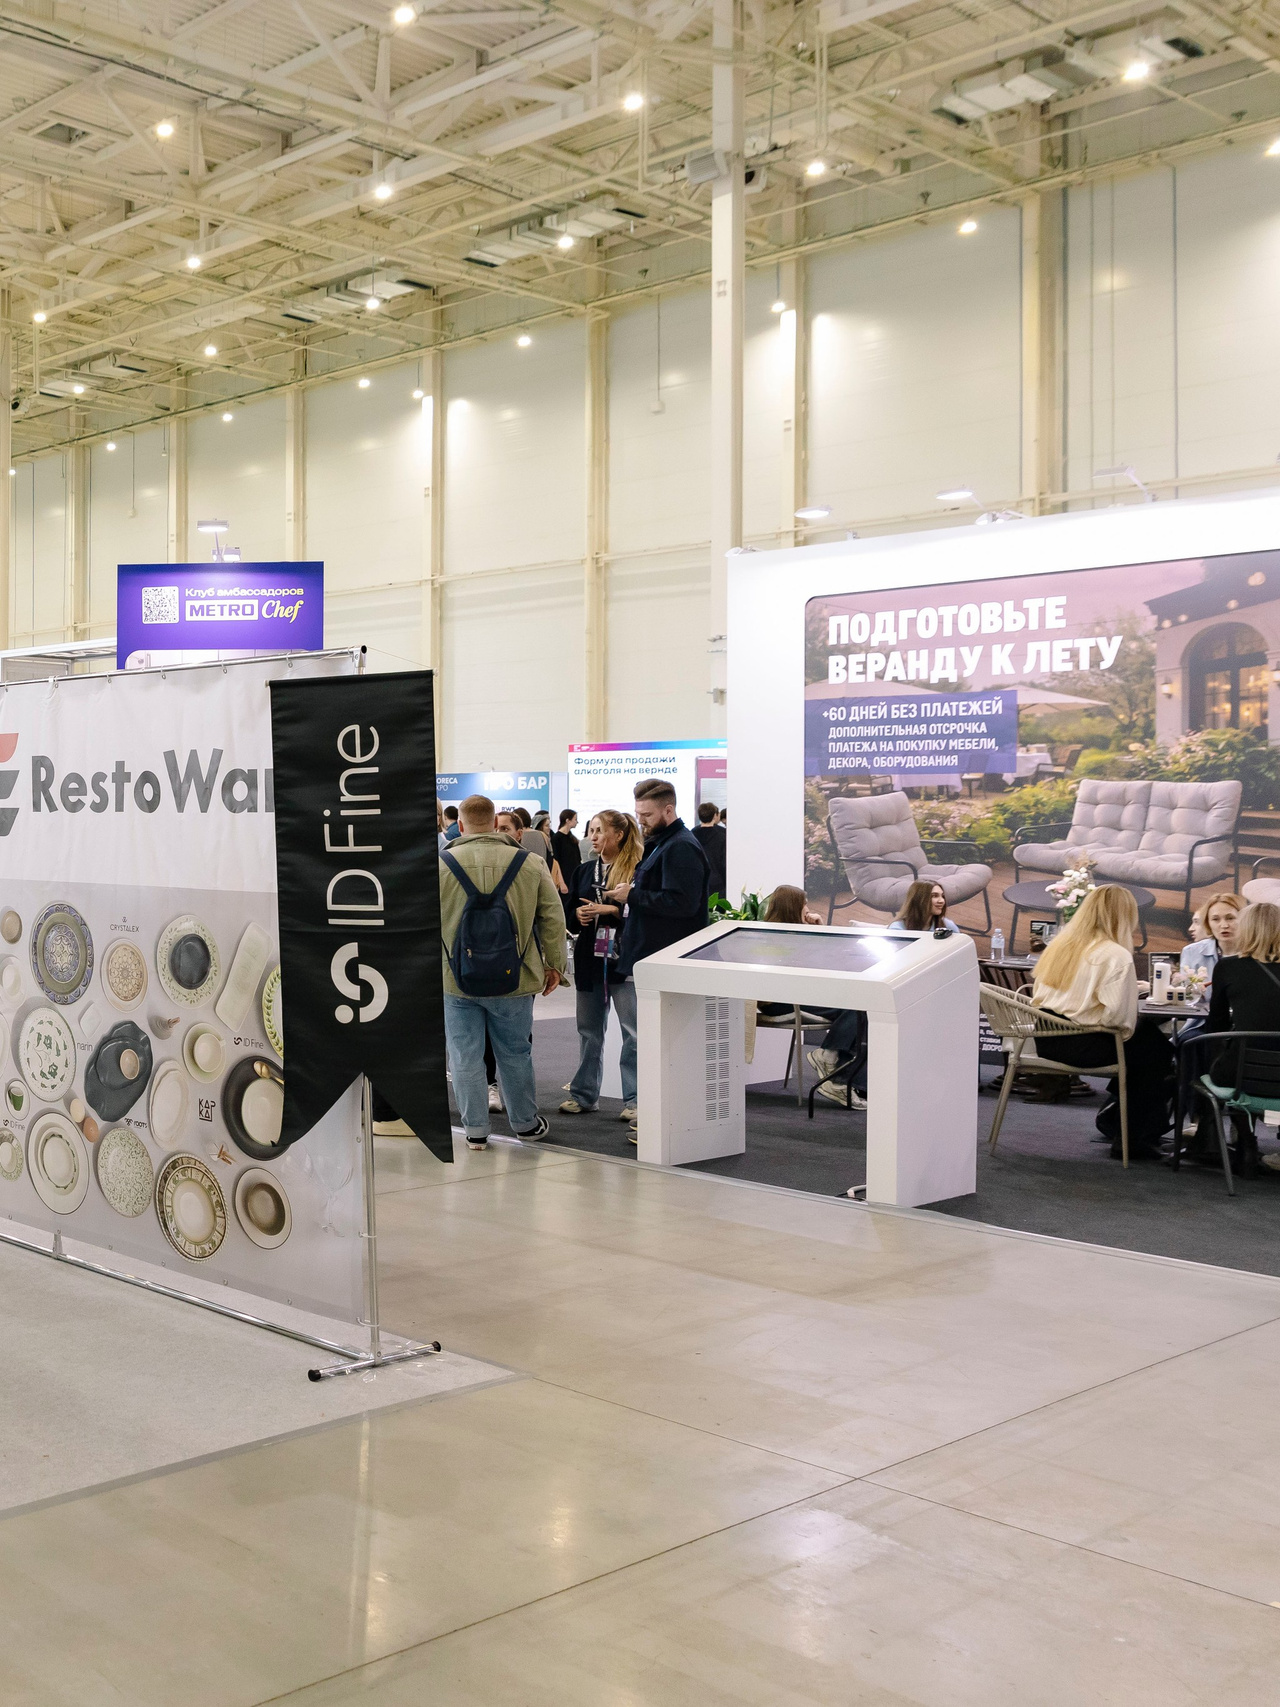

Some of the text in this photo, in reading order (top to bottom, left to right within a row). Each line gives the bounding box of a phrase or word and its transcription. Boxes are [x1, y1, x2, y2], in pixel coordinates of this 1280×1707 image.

[185, 587, 304, 598] Клуб амбассадоров
[189, 600, 304, 624] METRO Chef
[827, 595, 1068, 647] ПОДГОТОВЬТЕ
[827, 635, 1124, 685] ВЕРАНДУ К ЛЕТУ
[822, 696, 1003, 723] +60 ДНЕЙ БЕЗ ПЛАТЕЖЕЙ
[828, 721, 988, 739] ДОПОЛНИТЕЛЬНАЯ ОТСРОЧКА
[828, 736, 1000, 754] ПЛАТЕЖА НА ПОКУПКУ МЕБЕЛИ,
[574, 756, 676, 767] Формула продажи
[828, 753, 959, 770] ДЕКОРА, ОБОРУДОВАНИЯ
[574, 767, 621, 775] алкоголя
[623, 767, 636, 775] на
[436, 777, 458, 785] ORECA
[517, 776, 548, 790] БАР
[323, 723, 385, 927] ID Fine
[109, 924, 140, 933] CRYSTALEX
